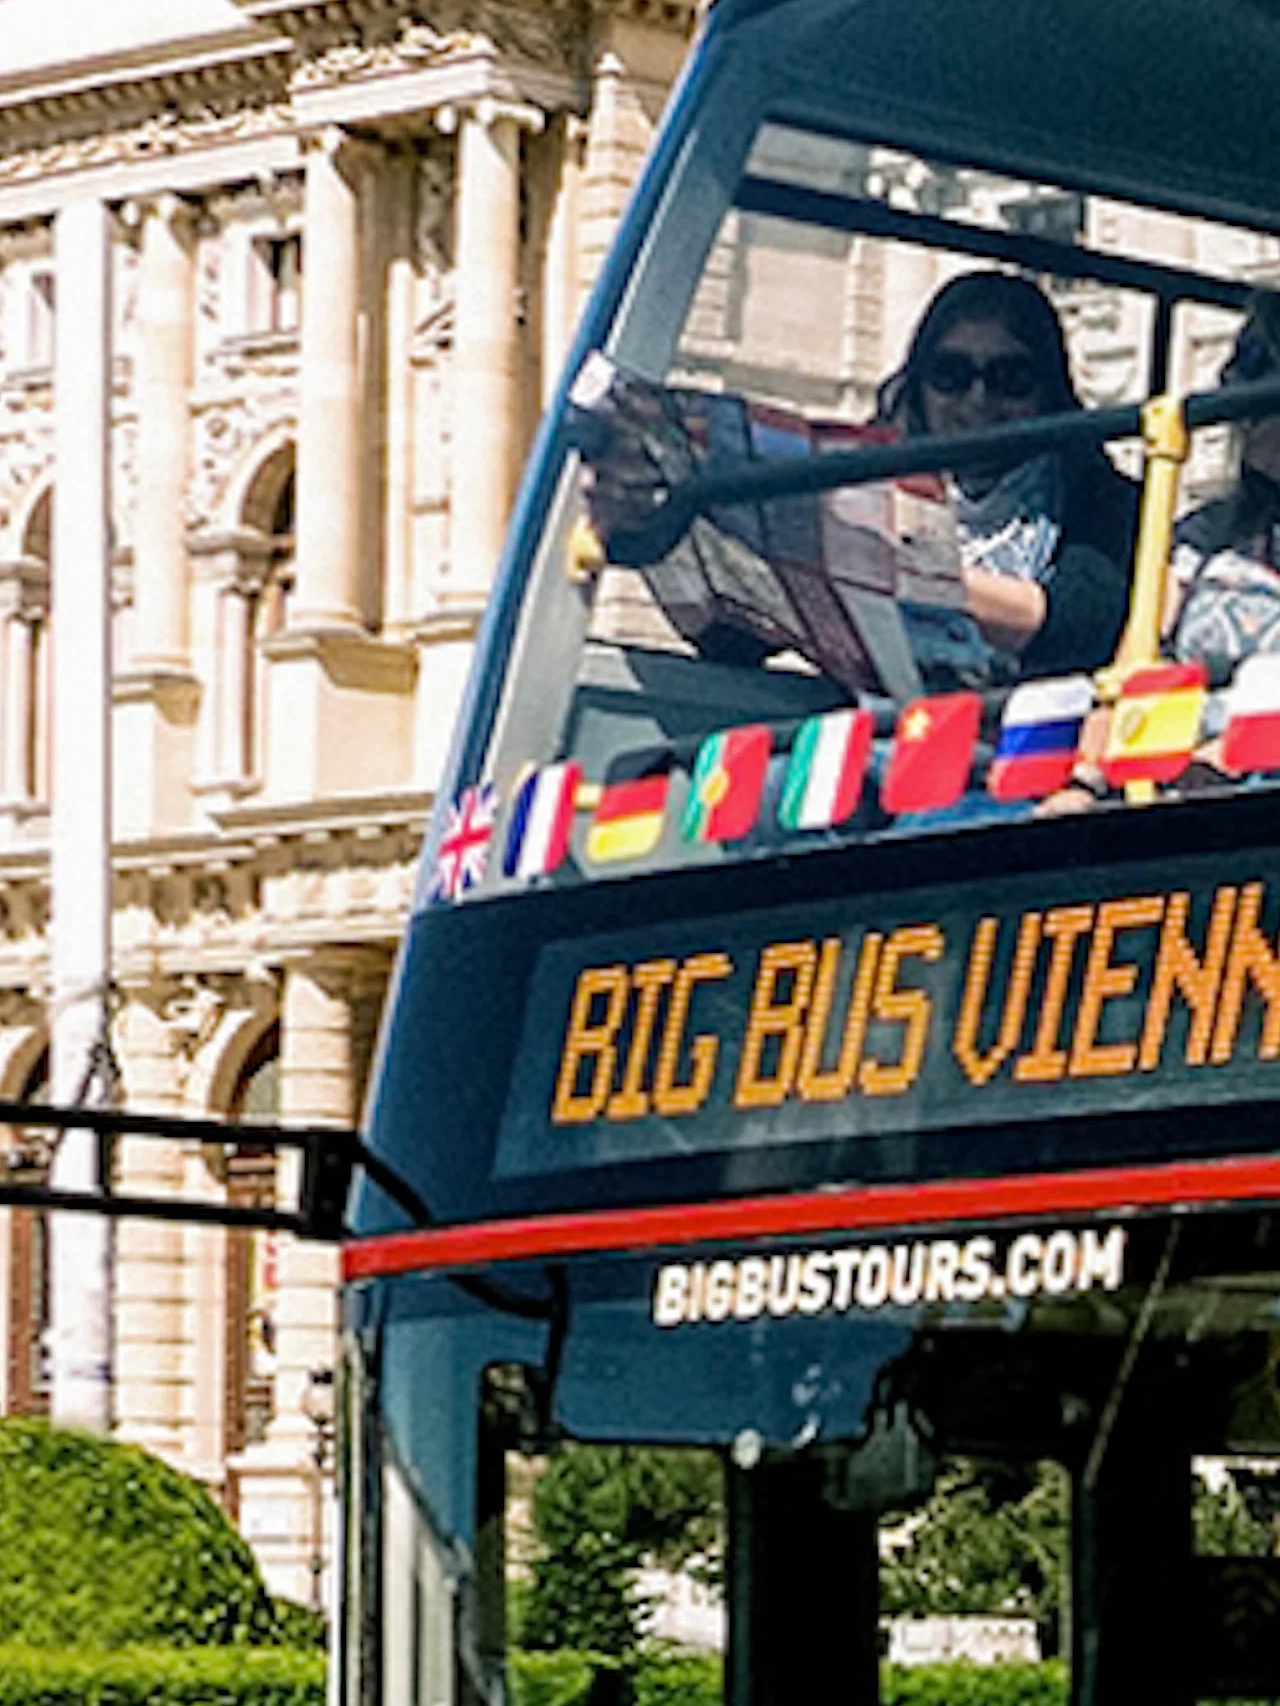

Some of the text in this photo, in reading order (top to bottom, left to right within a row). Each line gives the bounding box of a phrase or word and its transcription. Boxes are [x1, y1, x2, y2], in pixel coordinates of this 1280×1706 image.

[553, 955, 732, 1123] BIG
[737, 925, 943, 1108] BUS
[652, 1229, 1124, 1325] BIGBUSTOURS.COM
